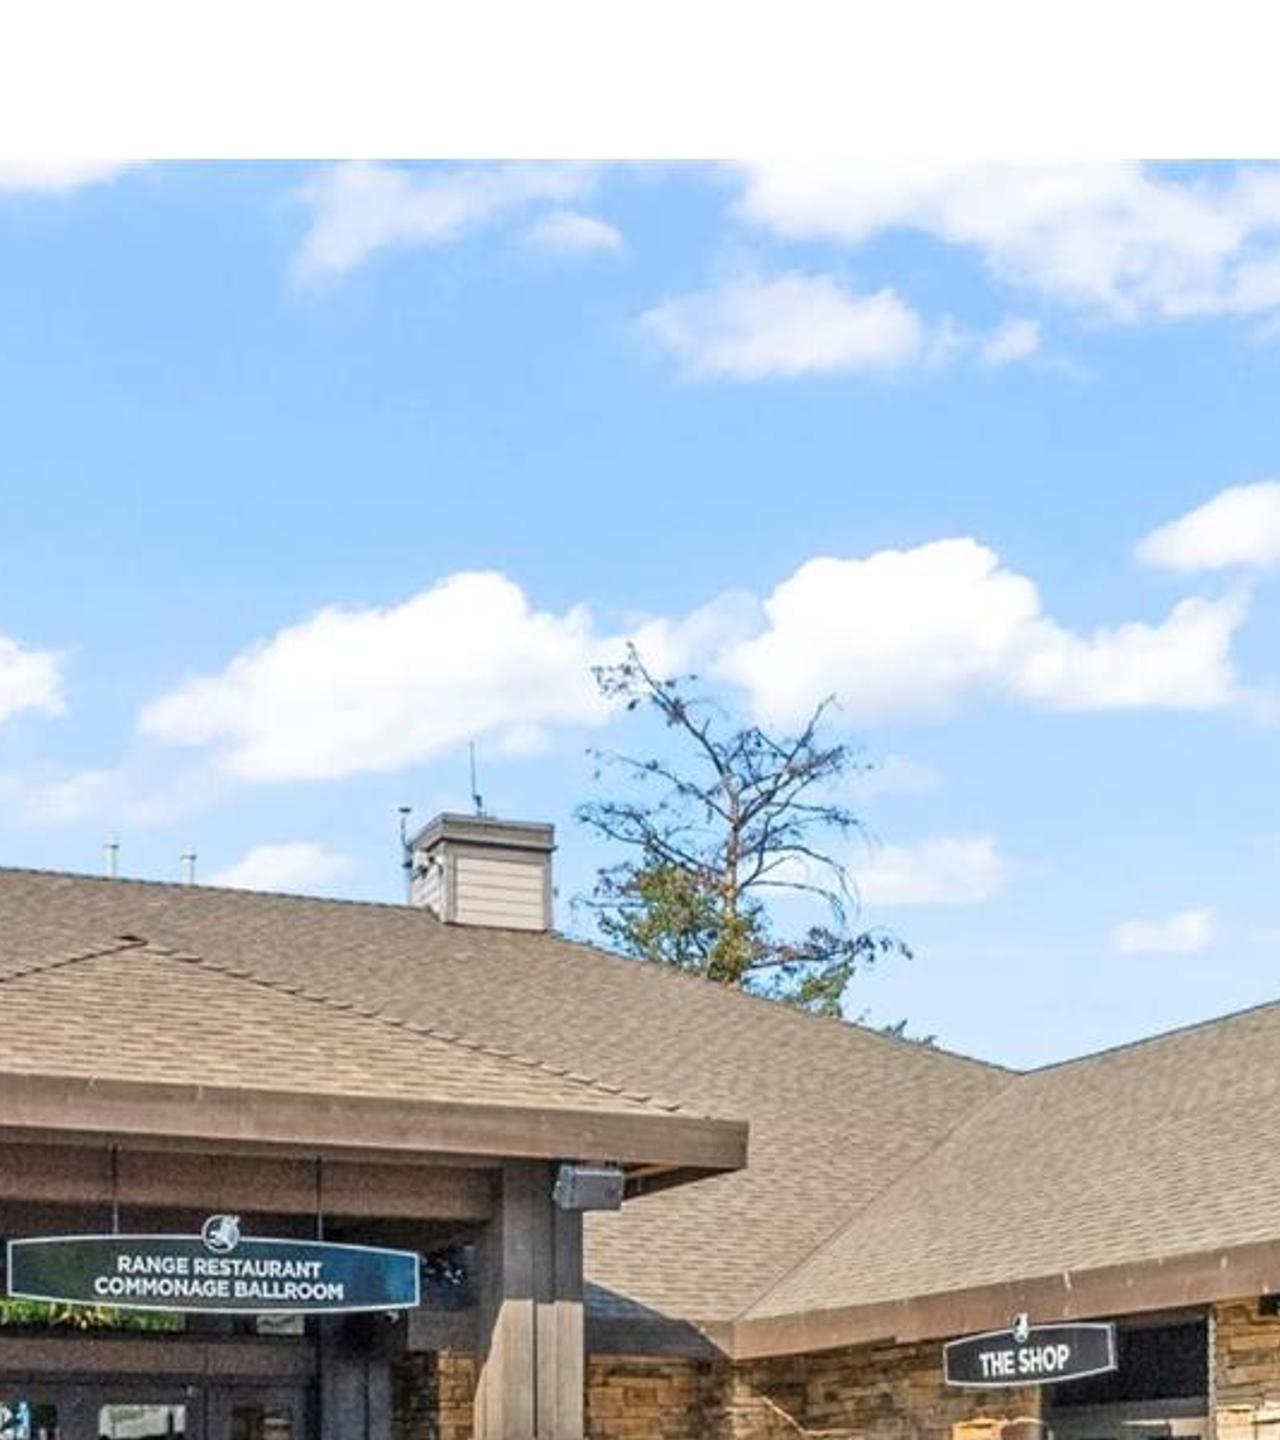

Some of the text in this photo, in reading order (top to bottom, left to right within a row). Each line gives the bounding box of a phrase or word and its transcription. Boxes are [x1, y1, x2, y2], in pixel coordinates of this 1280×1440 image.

[117, 1255, 323, 1279] RANGE RESTAURANT
[94, 1276, 345, 1301] COMMONAGE BALLROOM
[979, 1344, 1070, 1377] THE SHOP
